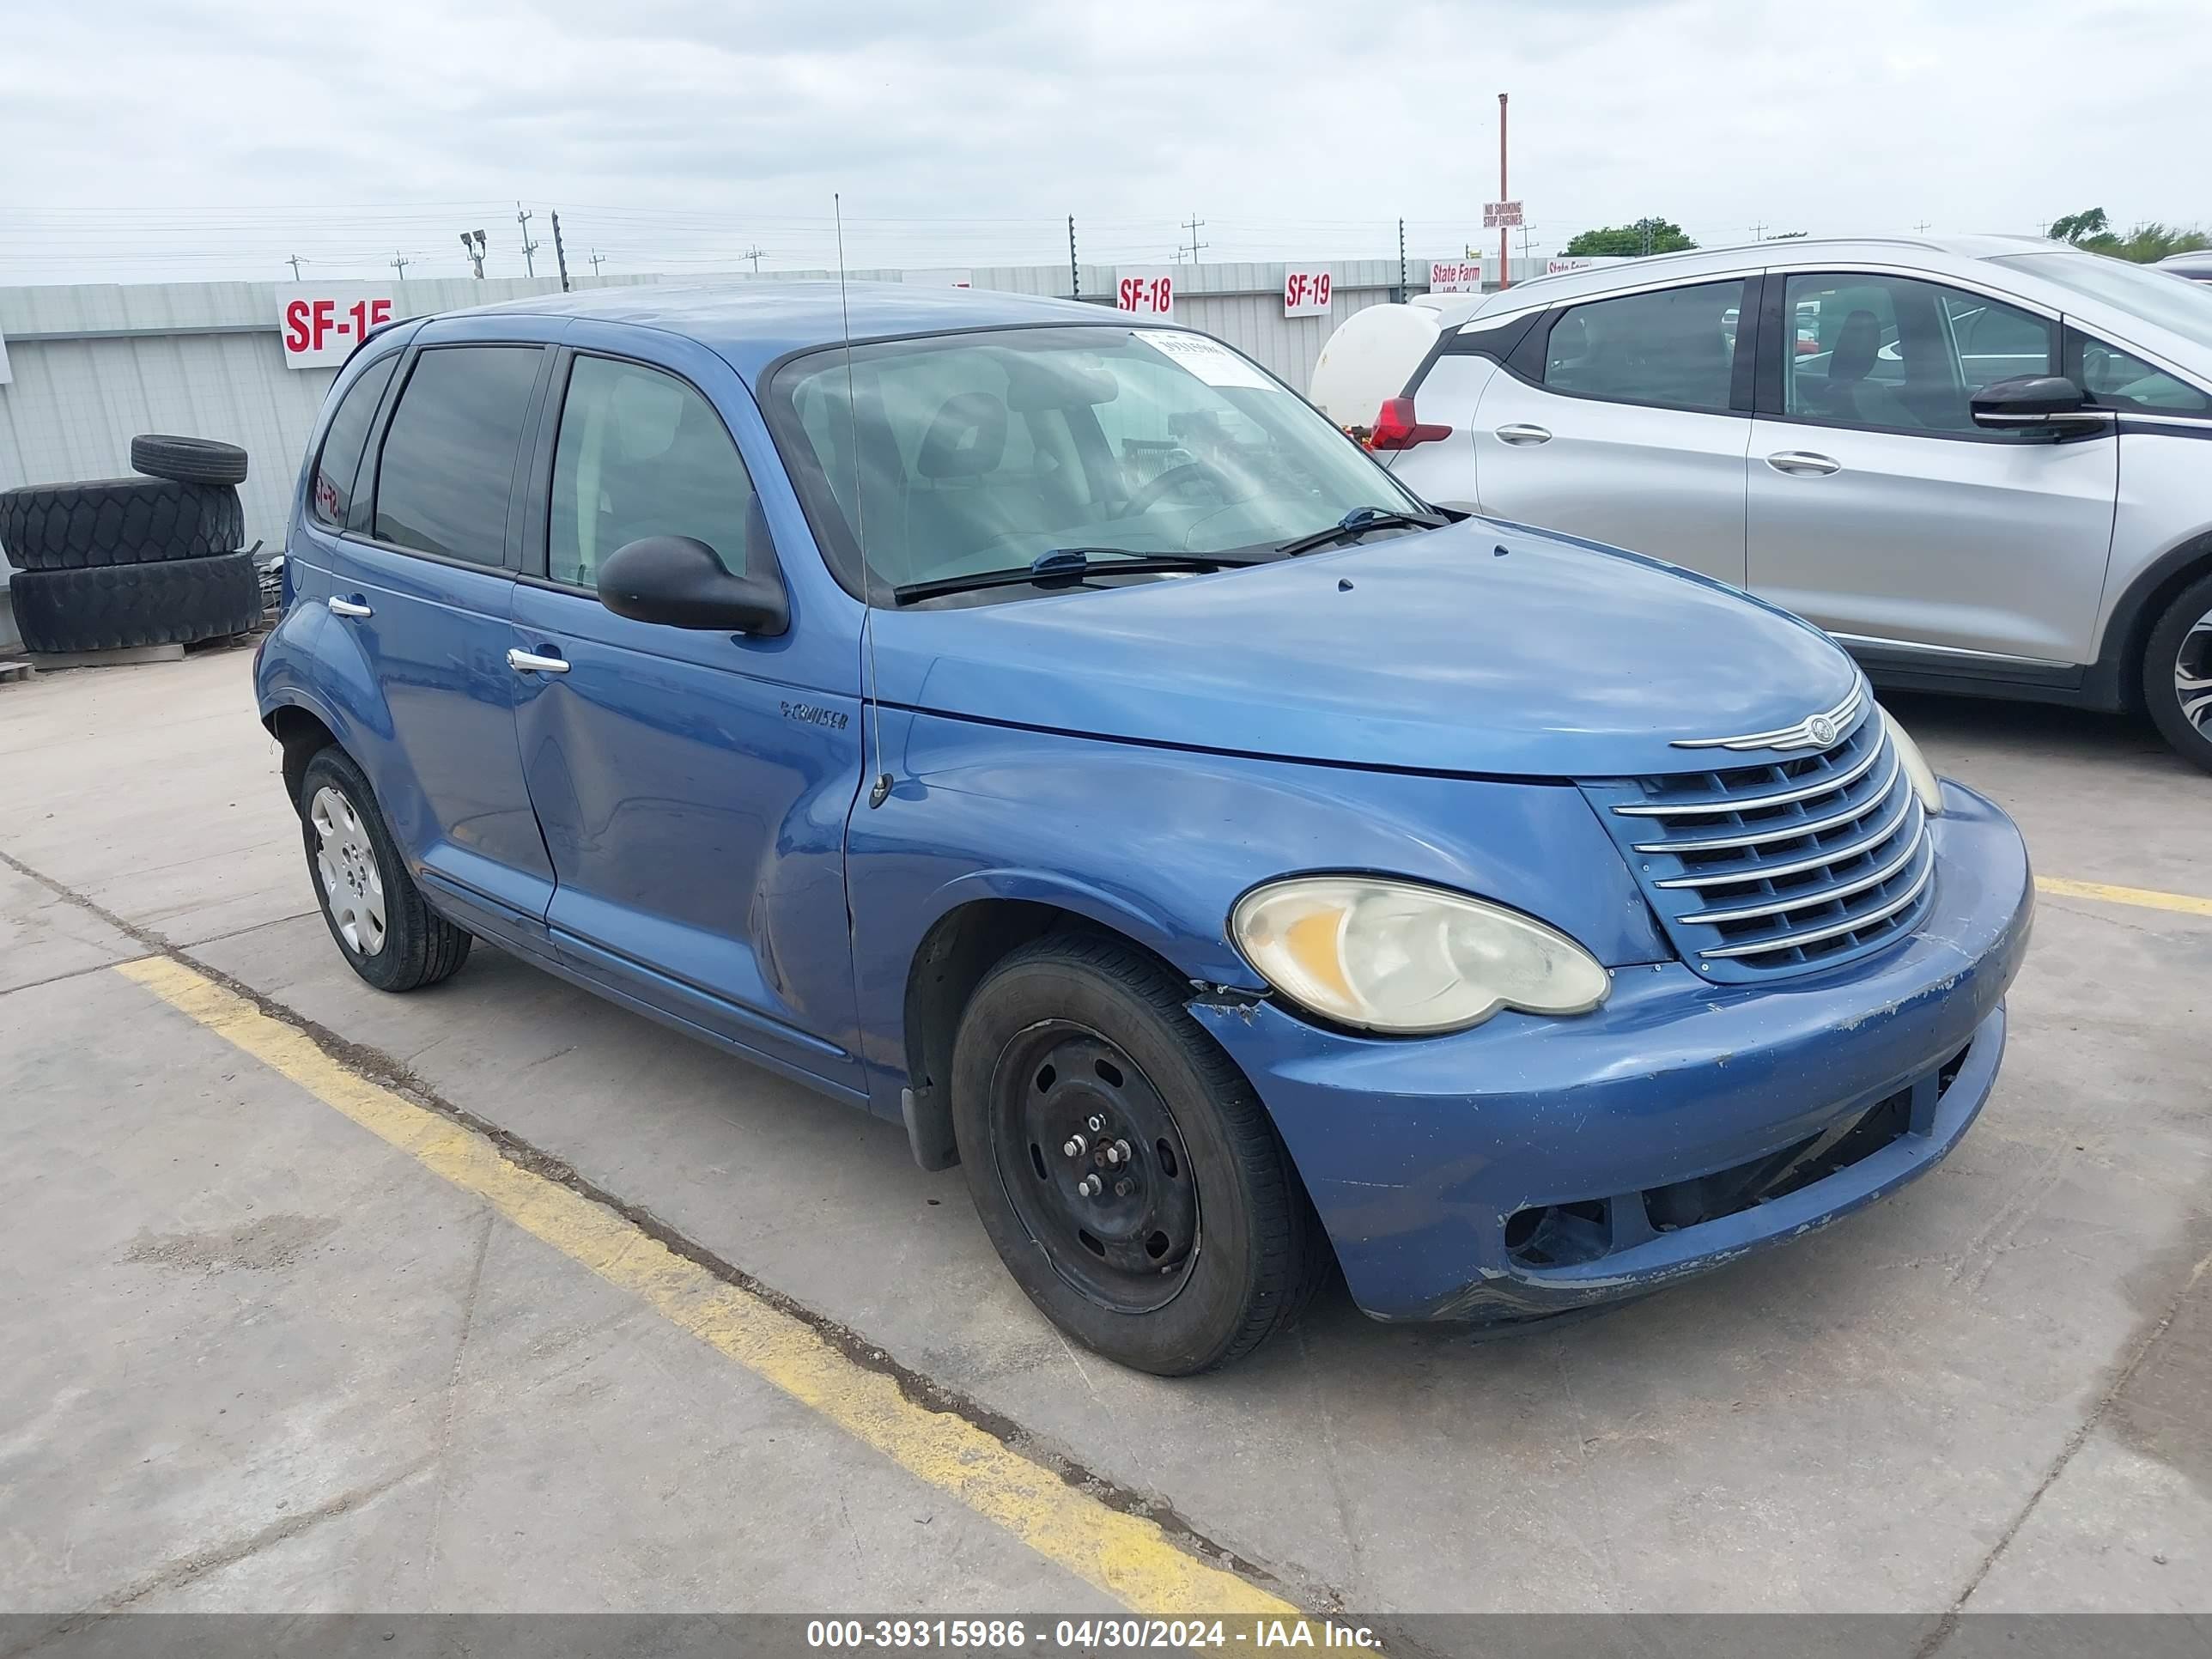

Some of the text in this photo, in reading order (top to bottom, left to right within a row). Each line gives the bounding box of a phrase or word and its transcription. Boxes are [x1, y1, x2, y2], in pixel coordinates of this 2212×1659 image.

[1485, 202, 1522, 216] NO SMOKING
[1483, 214, 1522, 228] STOP ENGINES
[1432, 263, 1480, 283] State Farm
[1120, 277, 1171, 313] SF-18
[1286, 274, 1330, 307] SF-19
